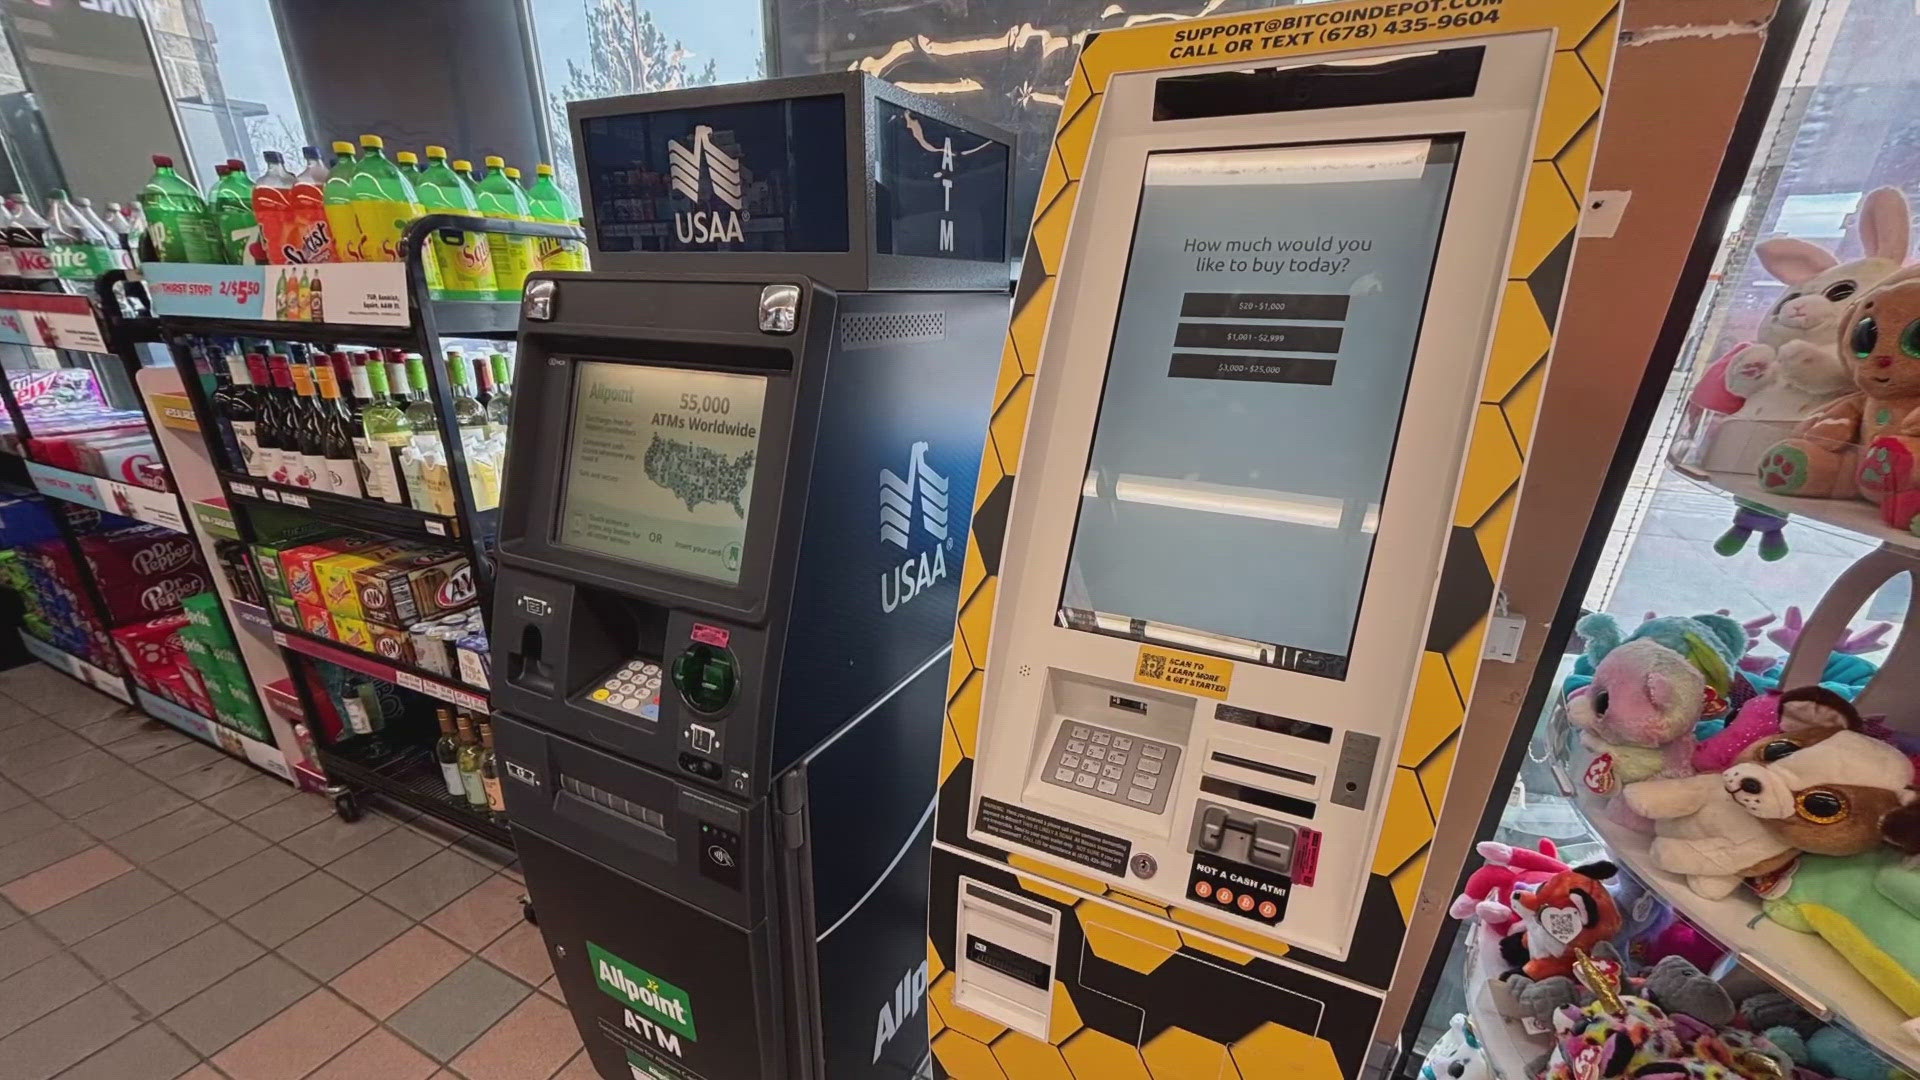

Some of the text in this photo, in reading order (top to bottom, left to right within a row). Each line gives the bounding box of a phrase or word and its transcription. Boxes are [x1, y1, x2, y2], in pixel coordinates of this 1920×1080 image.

[1170, 9, 1499, 59] CALL OR TEXT (678) 435-9604
[940, 137, 953, 252] ATM
[675, 211, 744, 244] USAA
[1184, 236, 1372, 255] How much would you
[1196, 257, 1350, 276] like to buy today?
[162, 283, 187, 294] THIRST
[1239, 302, 1253, 310] $20
[1258, 333, 1285, 343] $2,999
[589, 383, 634, 405] Allpoint
[679, 393, 730, 415] 55,000
[651, 412, 757, 439] ATMs Worldwide
[648, 532, 663, 545] OR
[132, 543, 190, 576] Pepper
[152, 541, 174, 558] Dr
[692, 545, 706, 555] your
[159, 577, 183, 594] Dr
[881, 542, 947, 614] USAA
[141, 579, 199, 612] Pepper
[1167, 666, 1220, 682] LEARN MORE
[1169, 658, 1205, 670] SCAN TO
[1173, 677, 1189, 685] GET
[1190, 681, 1227, 692] STARTED
[1196, 863, 1286, 896] NOT A CASH ATM!
[599, 958, 688, 1026] Allpoint
[624, 1007, 683, 1058] ATM
